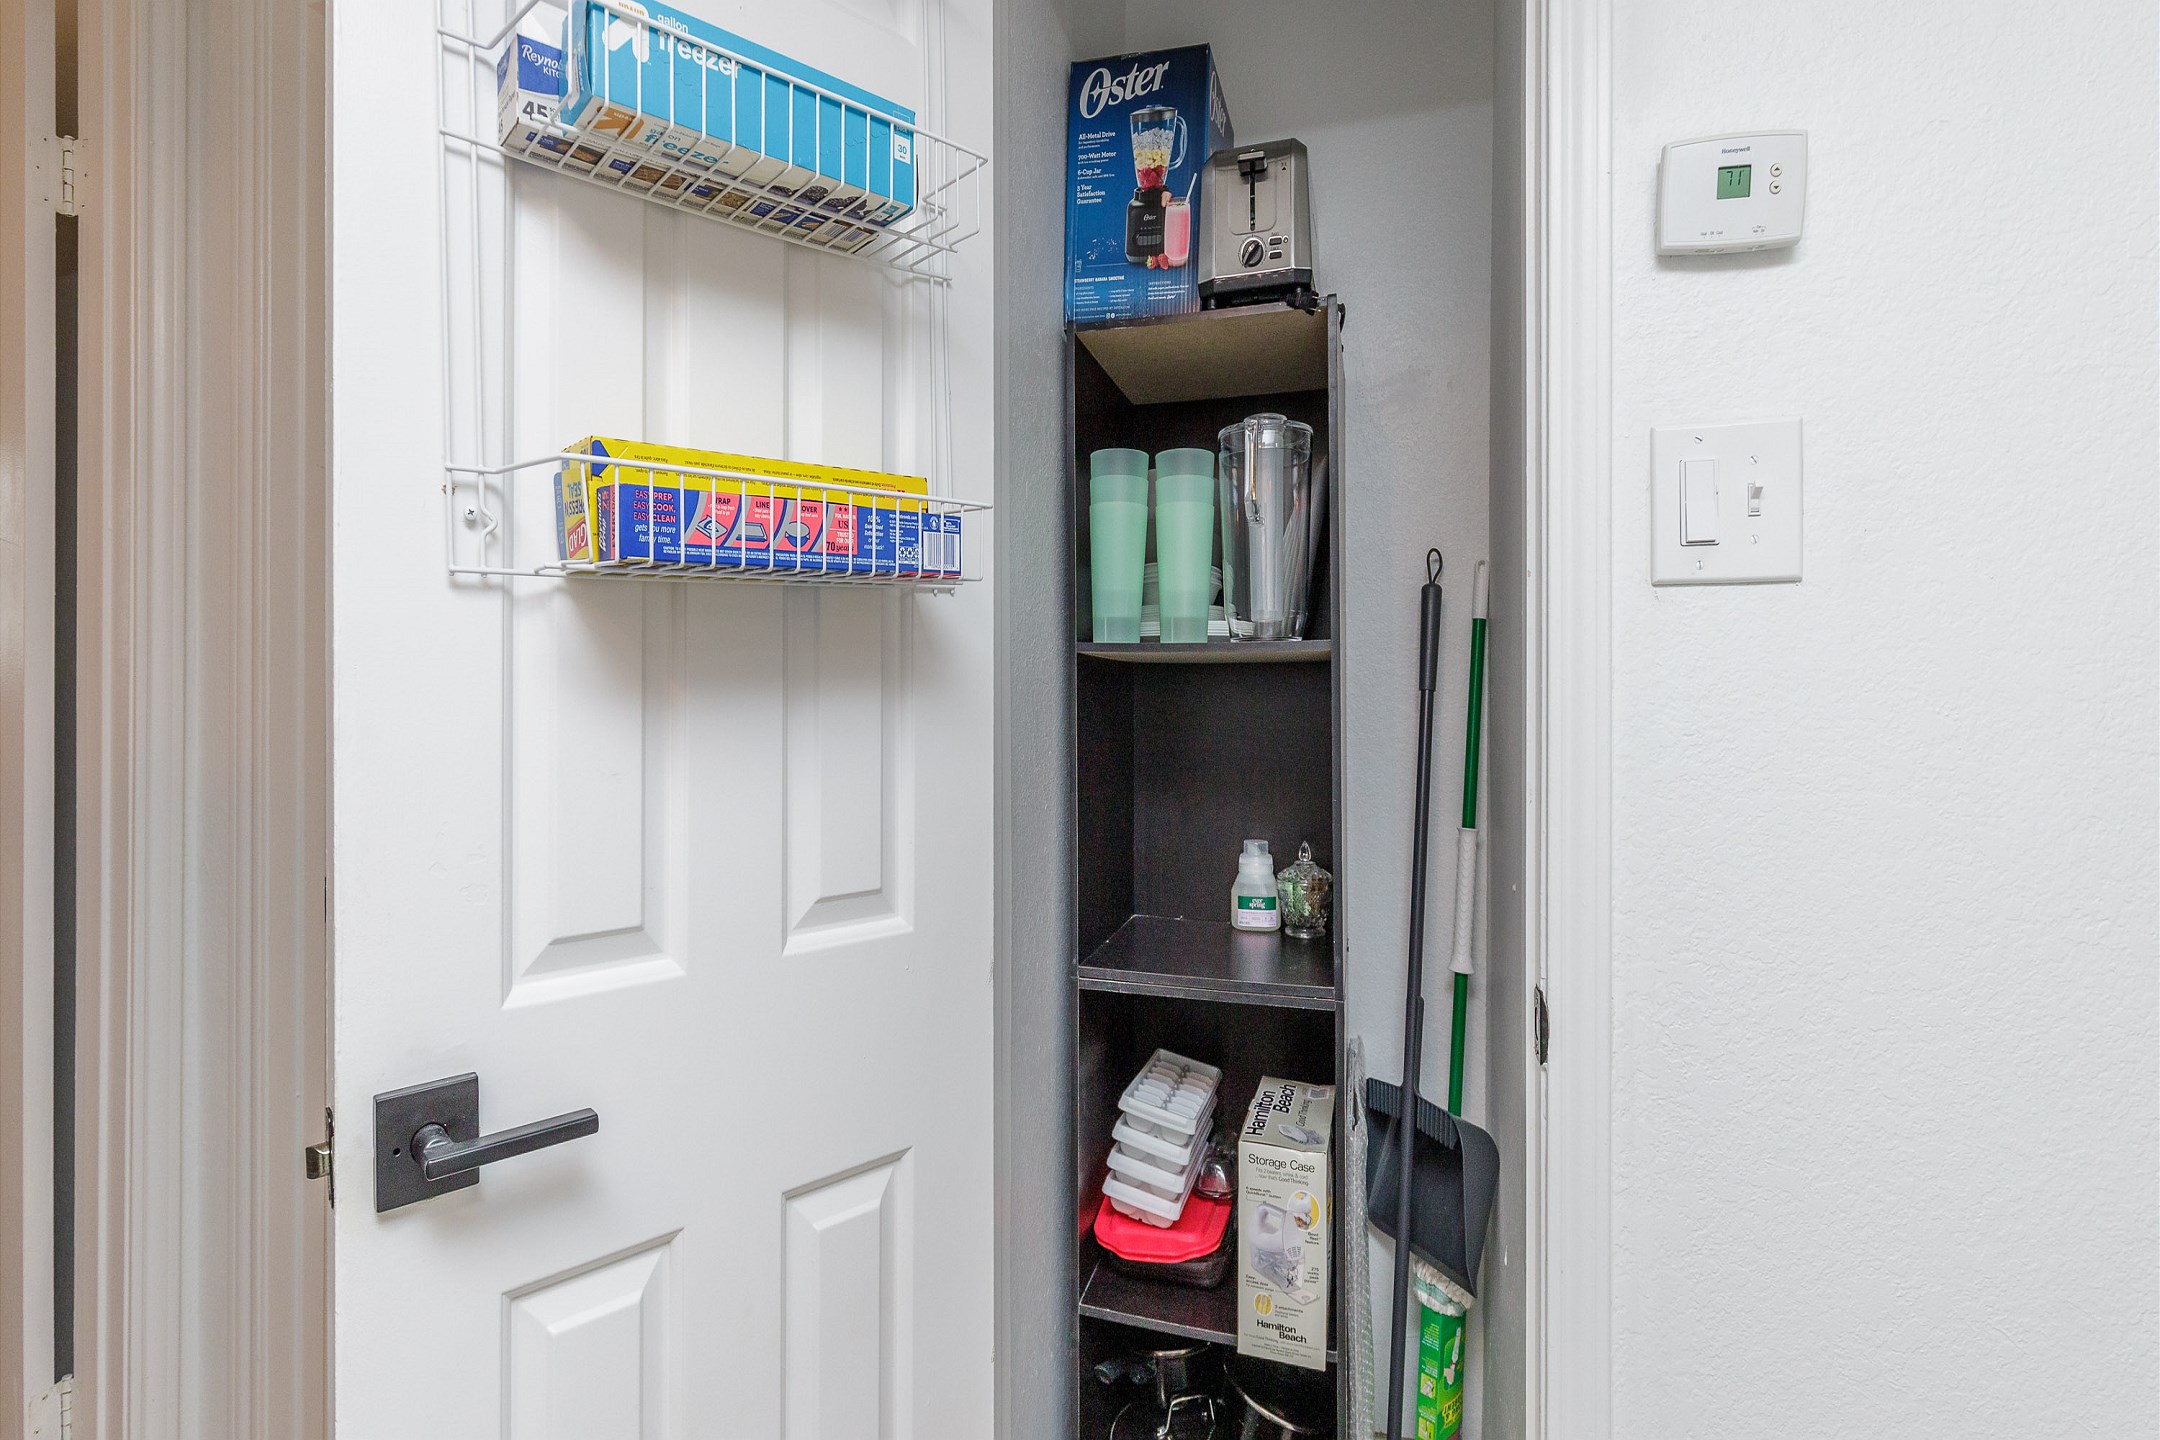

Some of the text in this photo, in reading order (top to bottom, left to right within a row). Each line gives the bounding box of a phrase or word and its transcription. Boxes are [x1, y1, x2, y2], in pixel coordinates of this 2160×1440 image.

[657, 14, 689, 34] gallon
[521, 44, 560, 67] Reyno
[1080, 61, 1170, 119] Oster
[522, 101, 549, 120] 45
[650, 129, 681, 142] gaon
[645, 133, 728, 164] feeze
[897, 144, 907, 155] 30
[1721, 146, 1751, 154] Honeywell
[1077, 153, 1101, 161] 700-Watt
[1077, 189, 1106, 198] Satisfaction
[1076, 197, 1102, 205] Guarantee
[567, 481, 582, 498] SEAL
[635, 489, 649, 499] EAS
[801, 505, 818, 513] OVER
[653, 513, 676, 523] CLEAN
[867, 515, 881, 523] 10%
[634, 524, 648, 533] gets
[568, 522, 587, 552] GLAD
[638, 534, 672, 544] famy time.
[826, 541, 836, 552] 70
[1272, 1084, 1297, 1114] Beach
[1245, 1090, 1277, 1136] Hamilton
[1248, 1153, 1315, 1173] Storage Case
[1256, 1318, 1297, 1334] Hamilton
[1279, 1331, 1307, 1344] Beach
